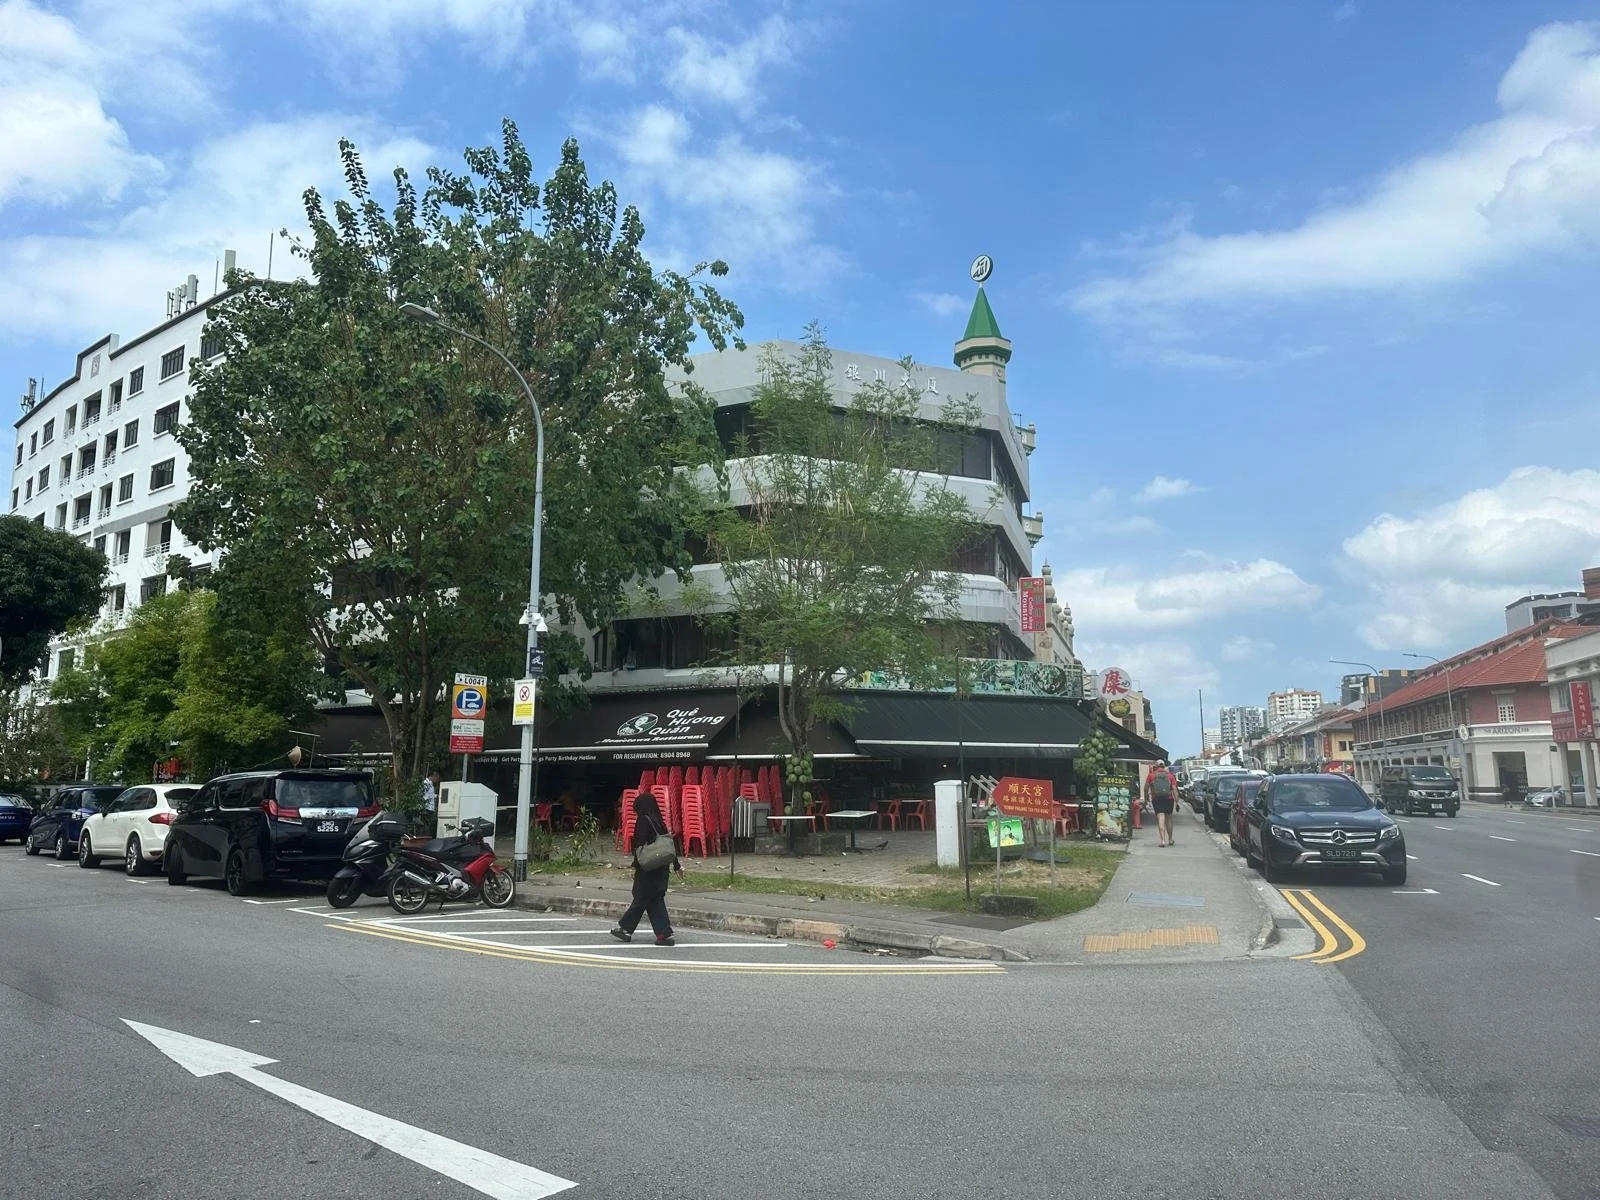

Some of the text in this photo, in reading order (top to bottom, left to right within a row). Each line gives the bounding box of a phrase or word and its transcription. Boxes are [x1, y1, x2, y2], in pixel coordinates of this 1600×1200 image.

[464, 677, 485, 686] L0041
[667, 707, 699, 718] Quê
[1008, 784, 1044, 797] 順天宮
